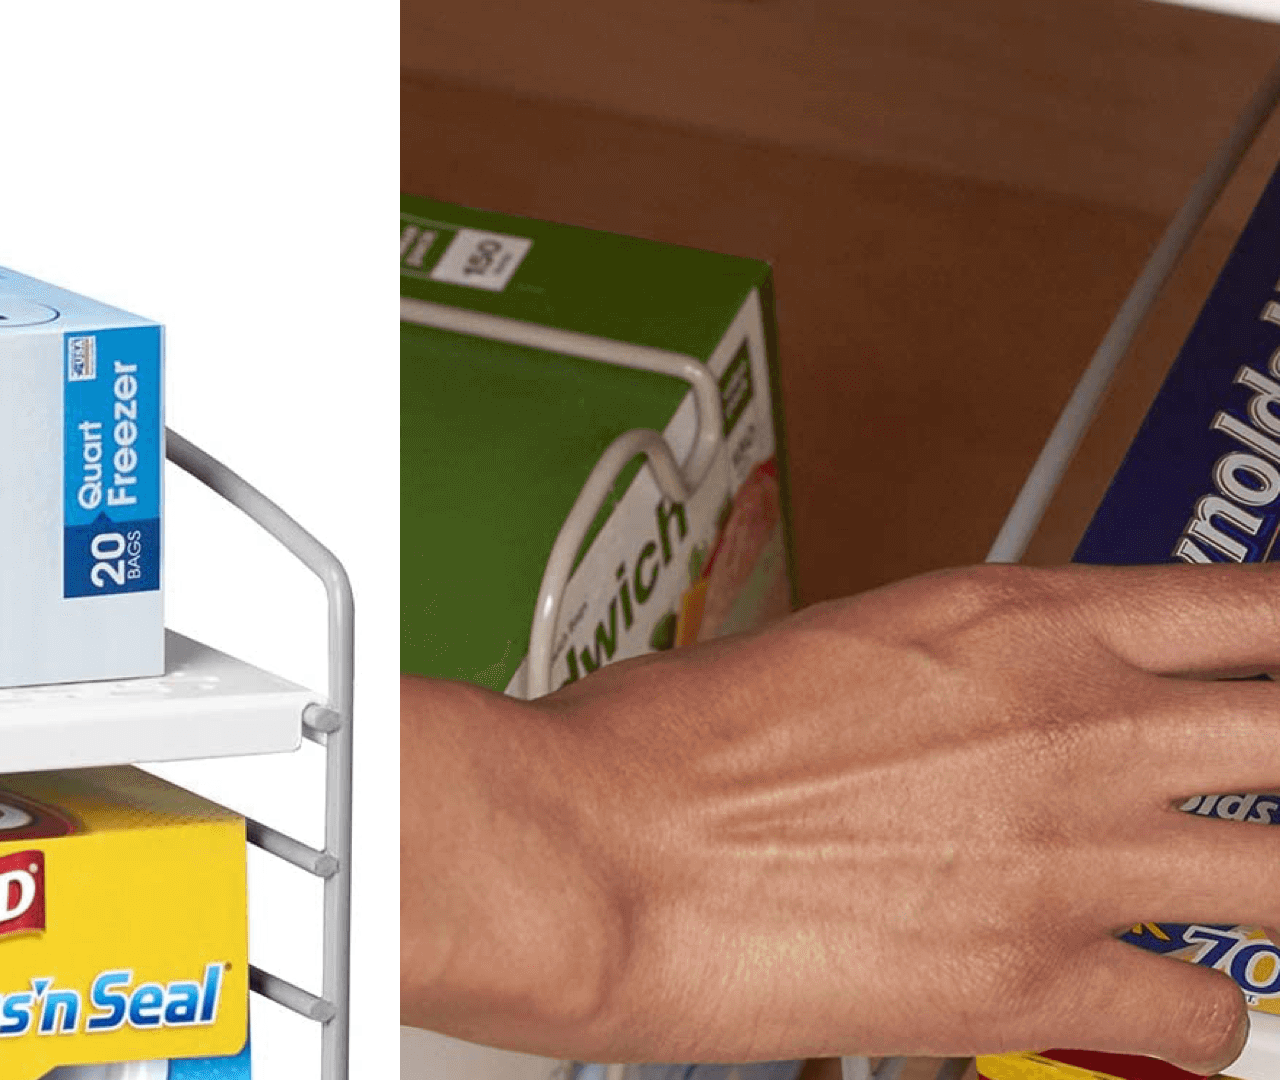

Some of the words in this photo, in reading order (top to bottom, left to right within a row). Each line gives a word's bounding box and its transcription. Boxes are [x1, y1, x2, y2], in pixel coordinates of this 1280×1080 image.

[77, 420, 103, 510] Quart
[107, 360, 138, 506] Freezer
[90, 532, 127, 588] 20
[127, 530, 141, 579] BAGS
[88, 962, 225, 1030] Seal
